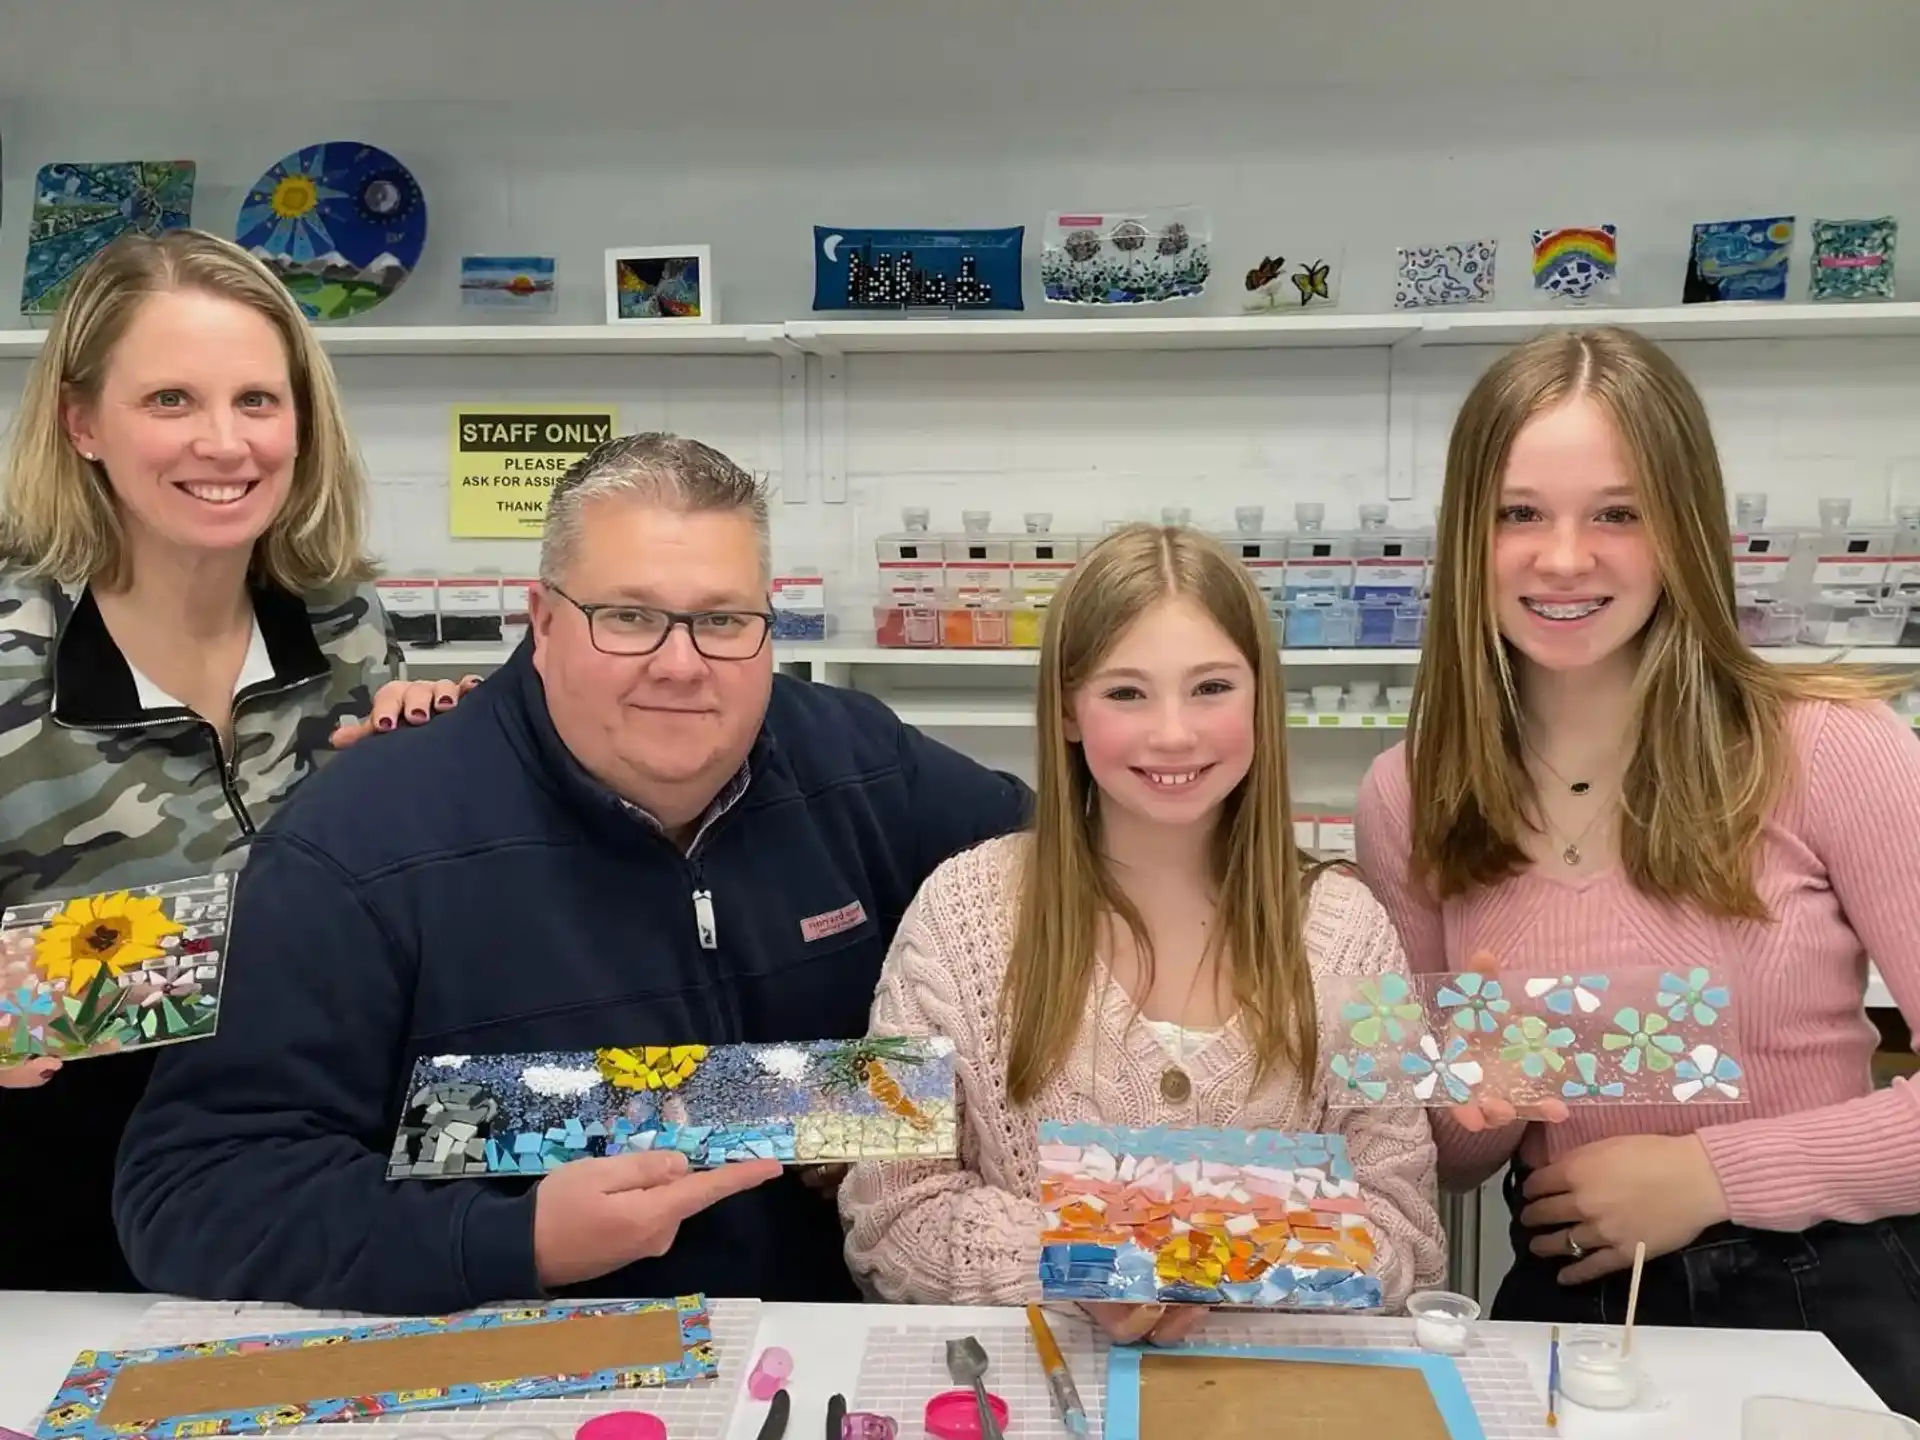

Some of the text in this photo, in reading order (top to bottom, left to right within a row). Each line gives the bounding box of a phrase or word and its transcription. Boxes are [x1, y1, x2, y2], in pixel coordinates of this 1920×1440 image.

[463, 423, 608, 443] STAFF ONLY
[505, 458, 566, 471] PLEASE
[462, 476, 489, 487] ASK
[494, 476, 520, 487] FOR
[496, 501, 543, 512] THANK
